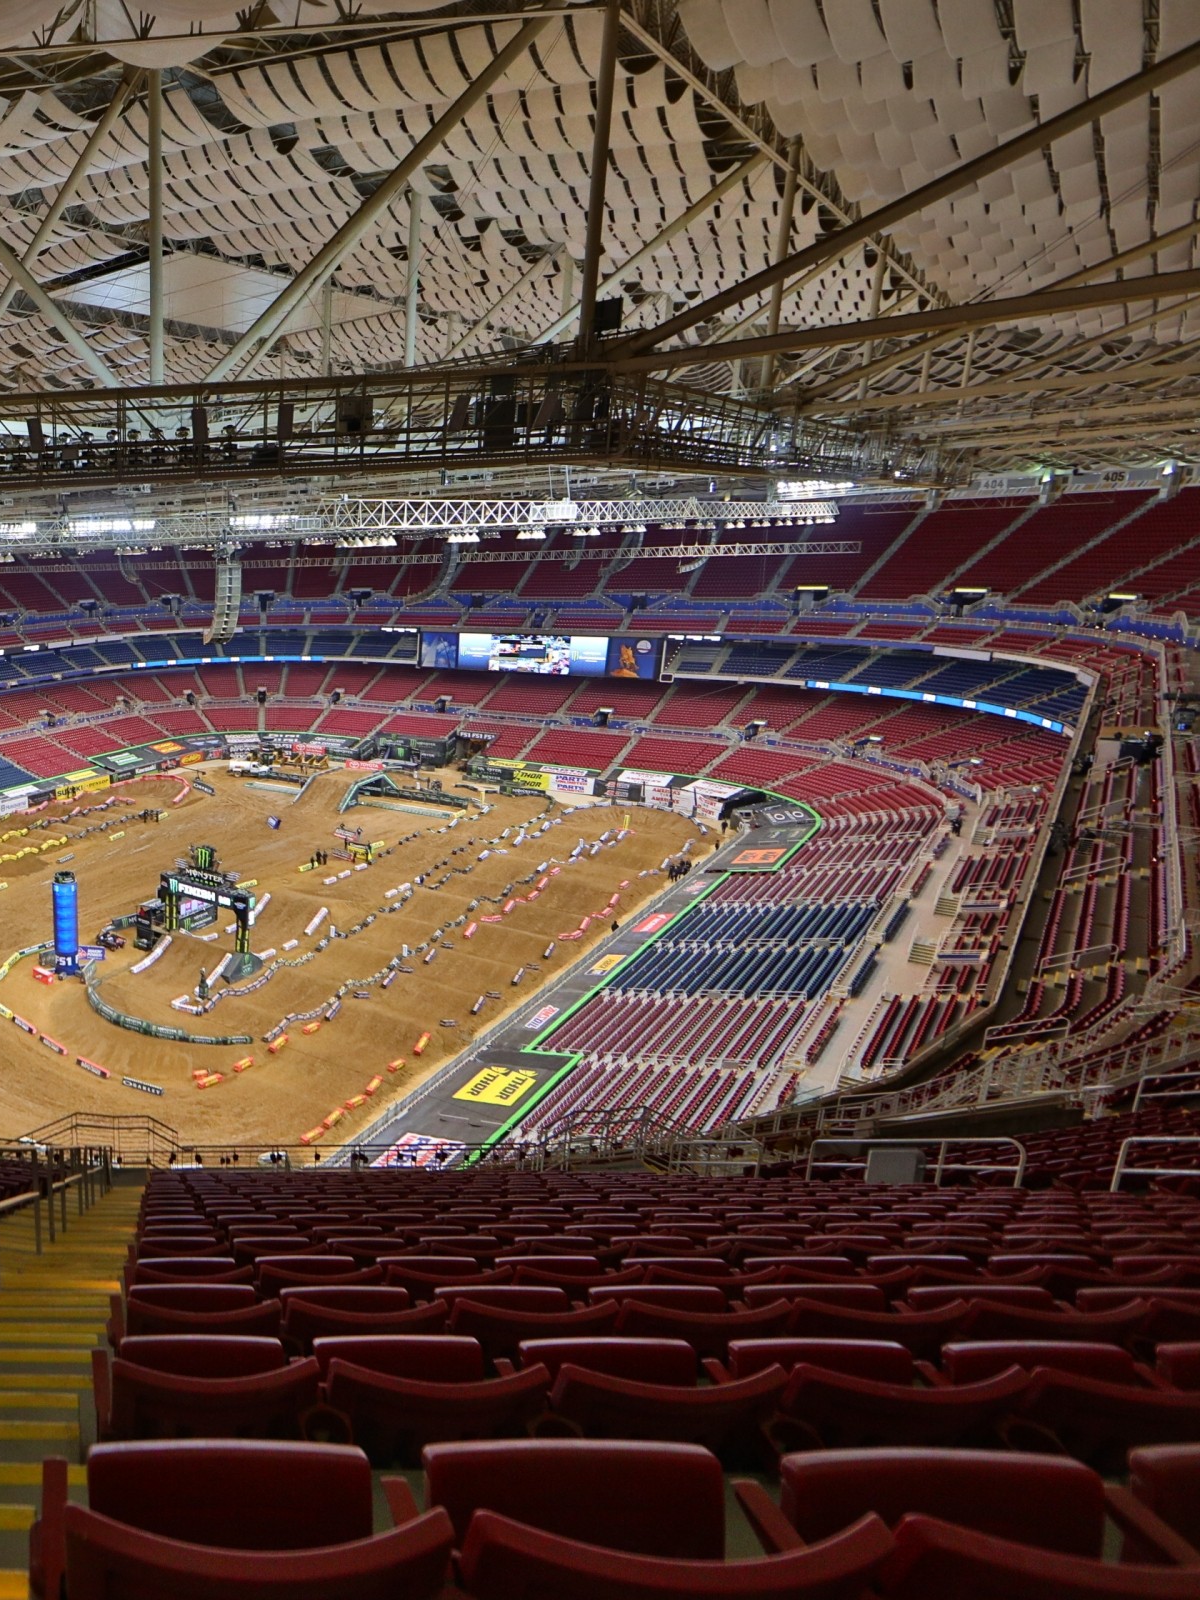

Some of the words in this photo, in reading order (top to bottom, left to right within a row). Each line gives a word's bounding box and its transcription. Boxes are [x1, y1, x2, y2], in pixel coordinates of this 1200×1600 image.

[983, 479, 1004, 490] 404
[1103, 471, 1125, 482] 405
[185, 868, 224, 884] MONSTER
[467, 1072, 499, 1097] THOR
[495, 1076, 527, 1101] THOR
